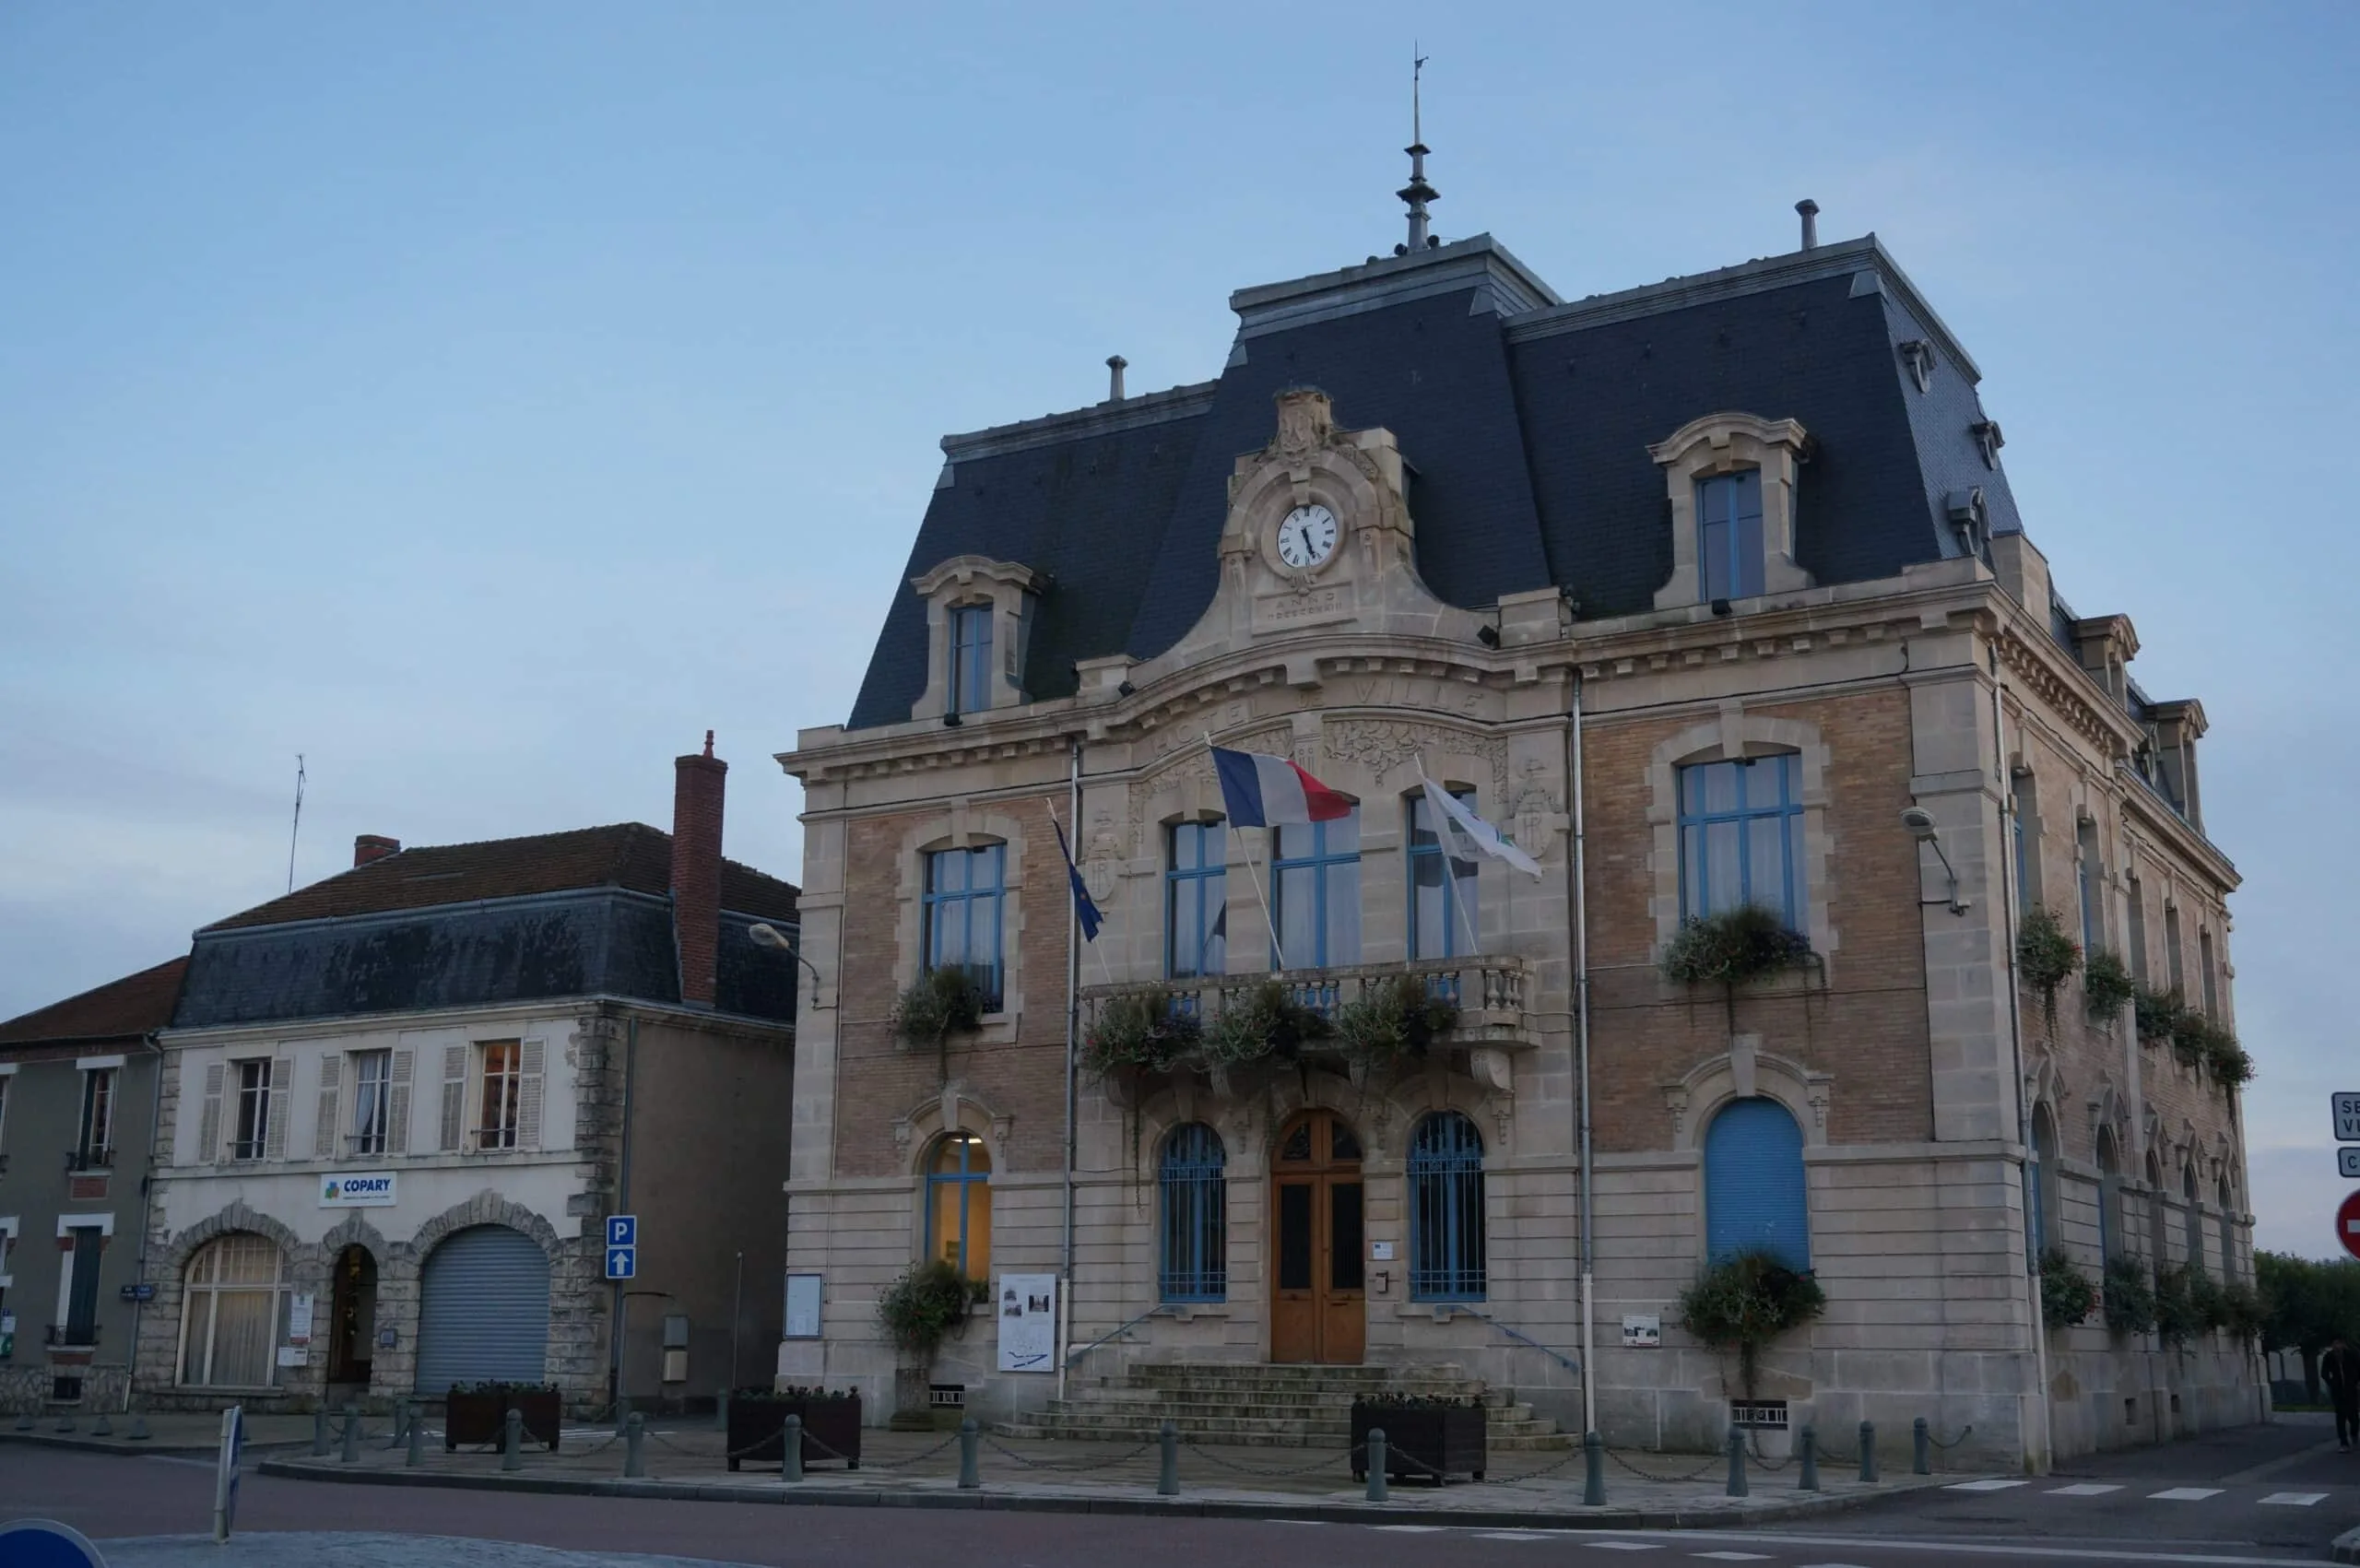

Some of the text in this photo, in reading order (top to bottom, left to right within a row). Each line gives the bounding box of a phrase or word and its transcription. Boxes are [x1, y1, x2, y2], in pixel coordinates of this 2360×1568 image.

[1352, 678, 1483, 716] VILLE
[344, 1179, 391, 1192] COPARY
[615, 1222, 628, 1241] P
